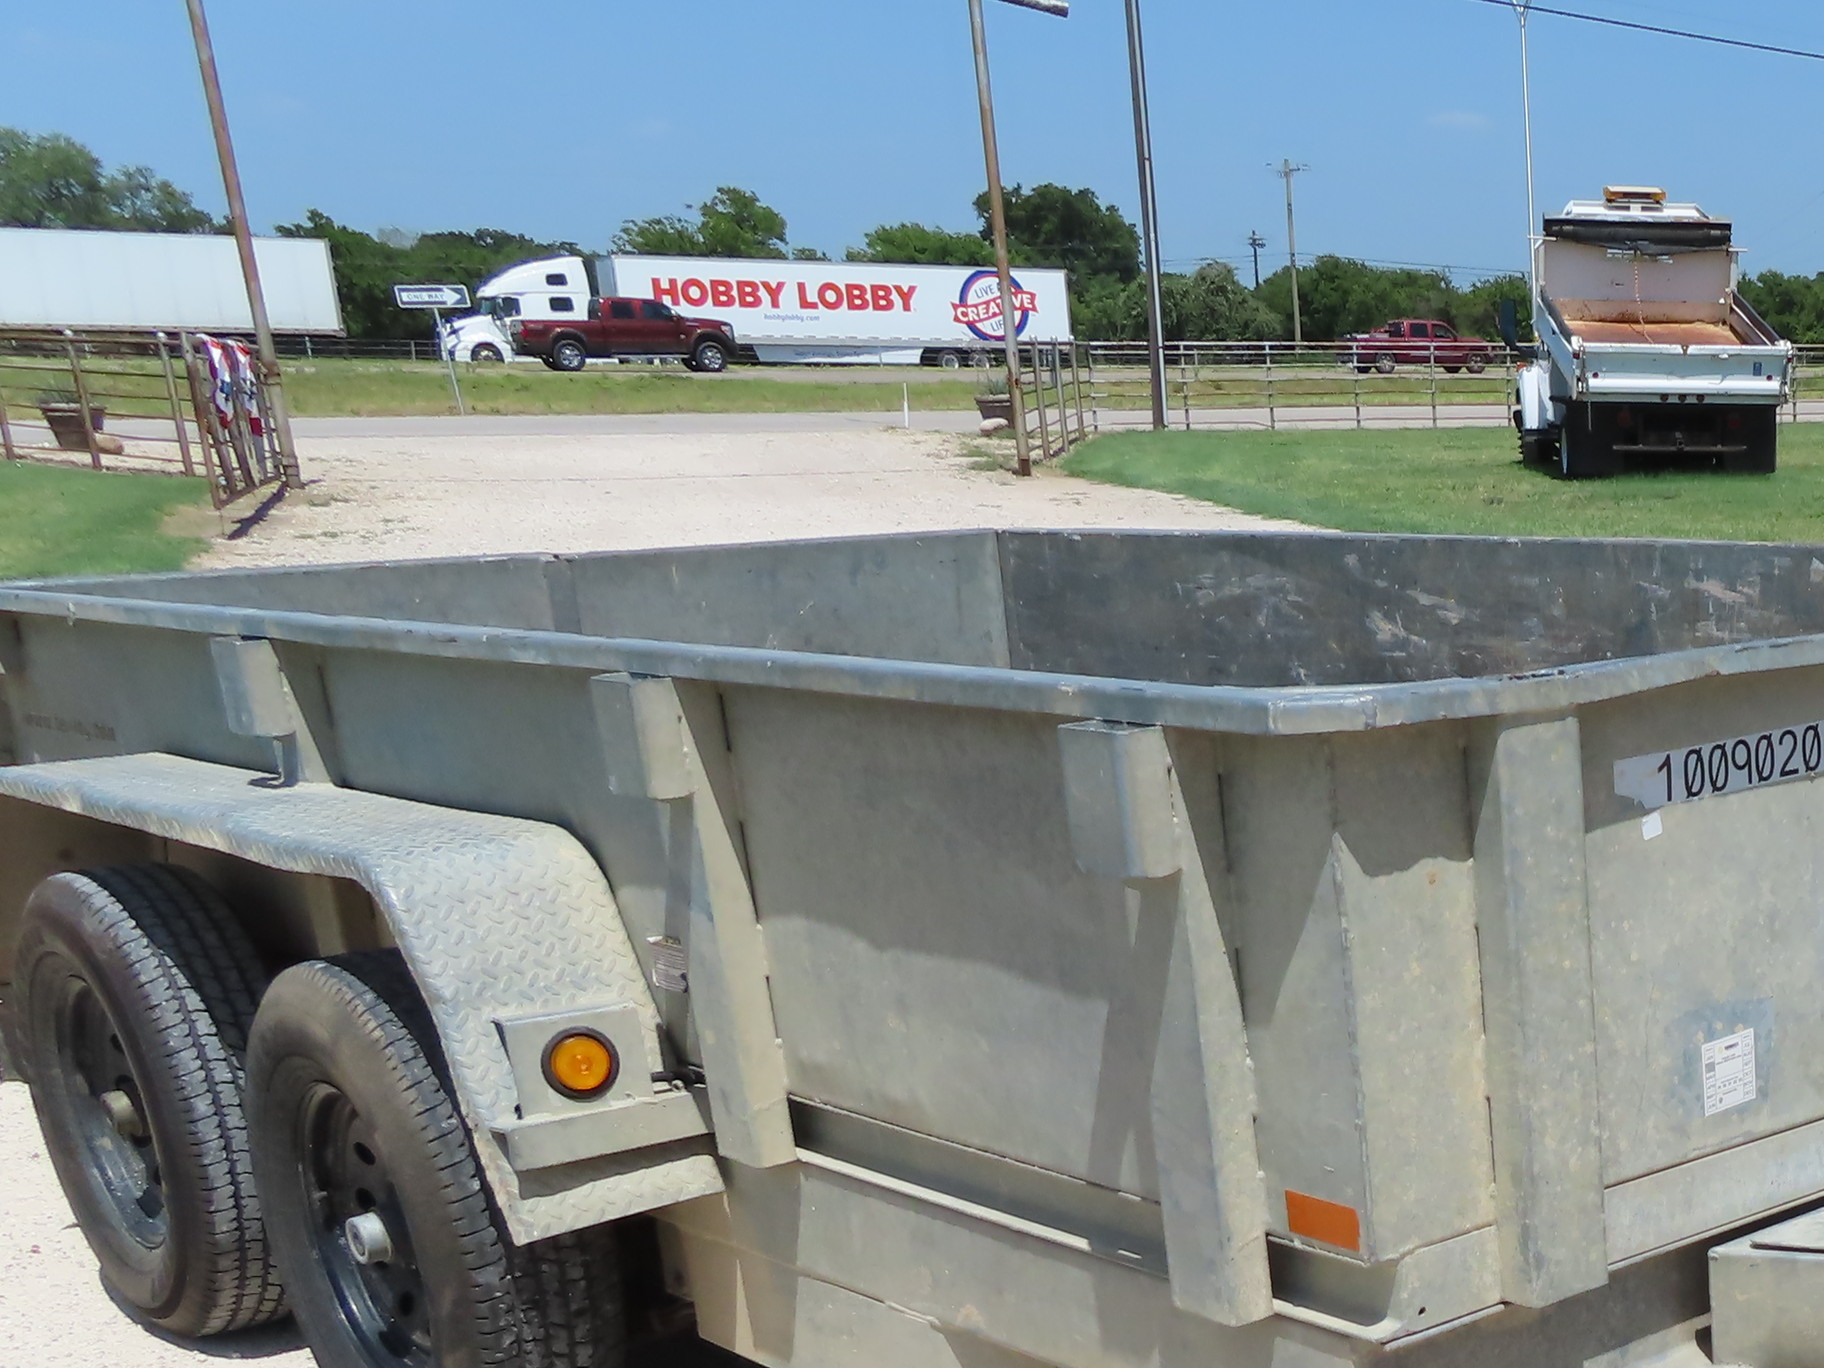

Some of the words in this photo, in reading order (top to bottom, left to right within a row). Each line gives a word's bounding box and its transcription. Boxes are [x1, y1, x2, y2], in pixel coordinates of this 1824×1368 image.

[406, 293, 425, 301] ONE
[428, 293, 445, 301] WAY
[651, 277, 786, 309] HOBBY
[797, 282, 917, 312] LOBBY
[974, 283, 996, 299] LIVE
[956, 294, 1033, 322] CREATVE
[990, 320, 1004, 332] LIF
[1657, 723, 1822, 802] 1009020
